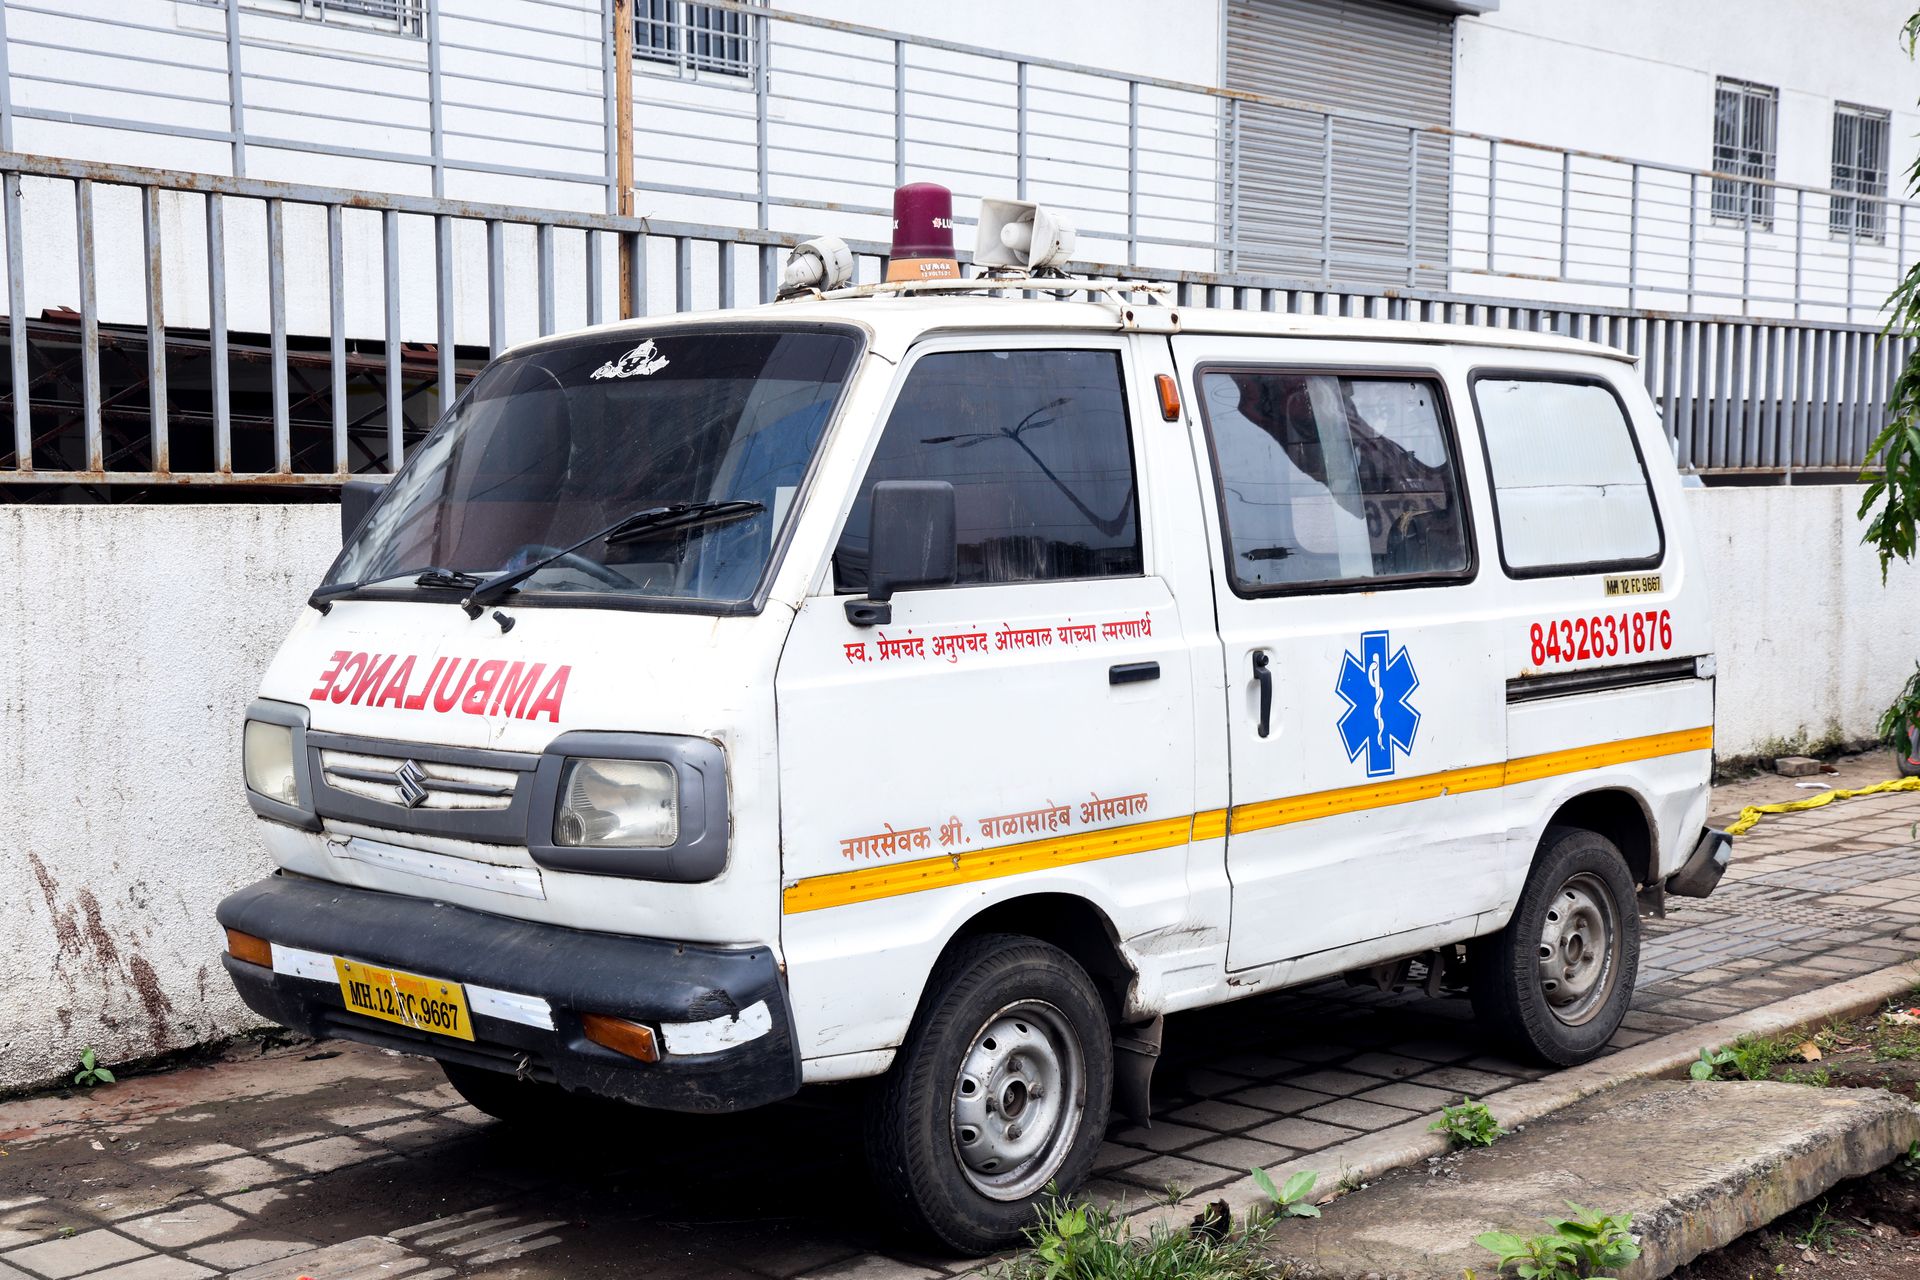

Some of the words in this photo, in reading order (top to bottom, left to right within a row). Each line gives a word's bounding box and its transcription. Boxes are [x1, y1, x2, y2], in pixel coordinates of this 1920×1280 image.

[1606, 579, 1619, 596] MH
[1620, 578, 1630, 594] 12
[1631, 577, 1641, 593] FC
[1642, 576, 1661, 592] 9667
[843, 641, 873, 664] स्व.
[877, 628, 925, 661] प्रेमचंद
[932, 624, 989, 663] अनुपचंद
[995, 622, 1051, 651] ओसवाल
[1057, 617, 1096, 645] यांच्या
[1101, 610, 1152, 642] स्मरणार्थ
[1530, 609, 1672, 666] 8432631876
[840, 822, 931, 861] नगरसेवक
[938, 815, 971, 846] श्री.
[978, 798, 1072, 838] बाळासाहेब
[1080, 791, 1149, 824] ओसवाल
